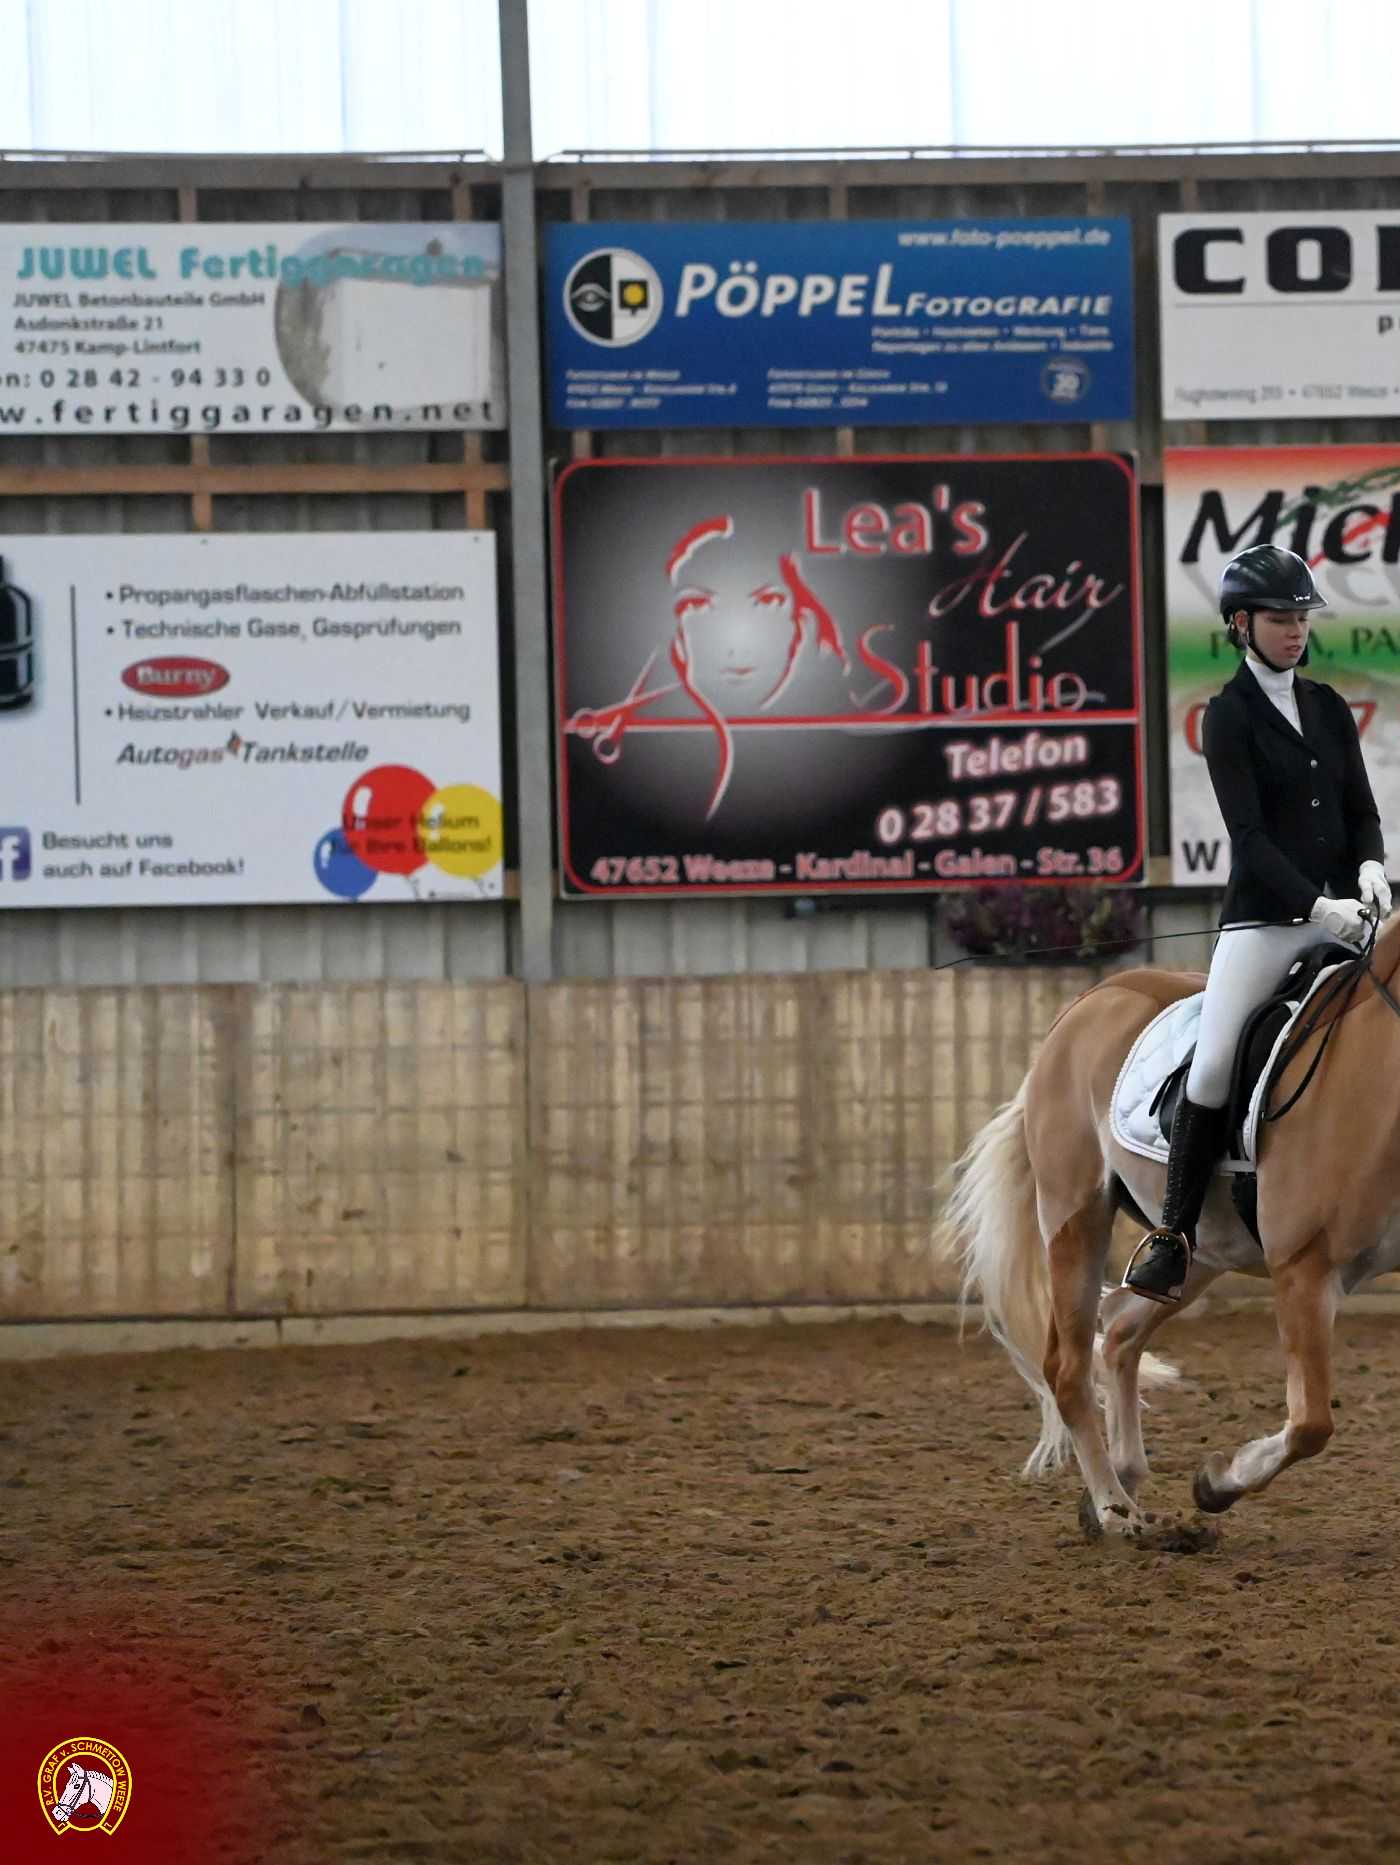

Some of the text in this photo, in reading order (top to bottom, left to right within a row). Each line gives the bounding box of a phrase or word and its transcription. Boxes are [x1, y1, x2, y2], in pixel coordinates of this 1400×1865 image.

[15, 246, 158, 280] JUWEL
[13, 291, 266, 308] JUWEL Betonbauteile GmbH
[905, 291, 1113, 318] FOTOGRAFIE
[143, 315, 163, 332] 21
[15, 338, 202, 356] 47475 Kamp-Lintfort
[66, 367, 98, 389] 28
[109, 368, 142, 389] 42
[170, 367, 203, 388] 94
[804, 484, 990, 557] Lea's
[928, 531, 1124, 618] Hair
[122, 617, 241, 640] Technische
[850, 620, 1107, 716] Studio
[117, 702, 244, 721] Heizstrahler
[116, 738, 369, 770] Autogas Tankstelle
[944, 731, 1088, 780] Telefon
[877, 807, 905, 844] 0
[910, 800, 962, 841] 28
[967, 792, 1018, 834] 37
[1047, 777, 1123, 821] 583
[42, 830, 174, 850] Besucht uns
[42, 857, 245, 879] auch auf Facebook!
[589, 854, 681, 884] 47652
[795, 848, 915, 881] Kardinal
[933, 847, 1019, 878] Galen
